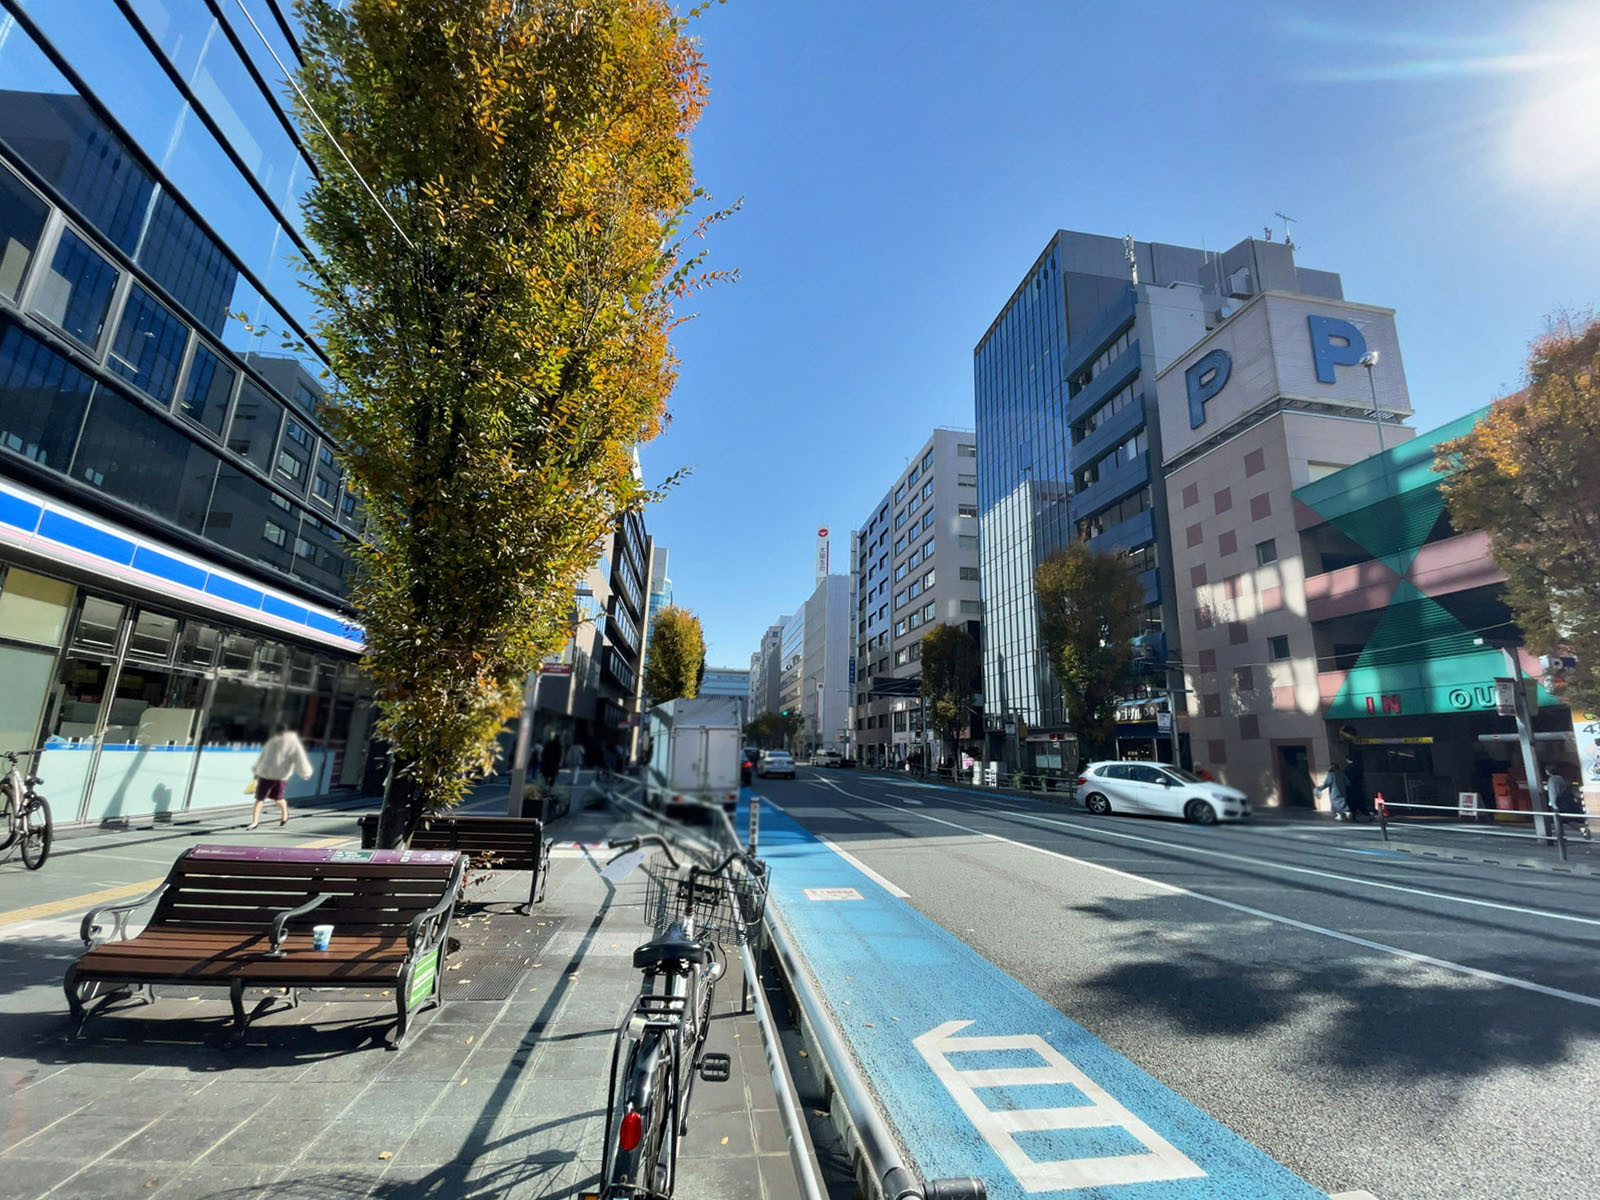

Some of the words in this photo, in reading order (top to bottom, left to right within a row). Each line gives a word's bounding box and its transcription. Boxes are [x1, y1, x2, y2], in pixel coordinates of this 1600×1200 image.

[1307, 315, 1366, 384] P
[1185, 349, 1232, 430] P
[1365, 694, 1402, 714] IN
[1449, 686, 1497, 710] OU
